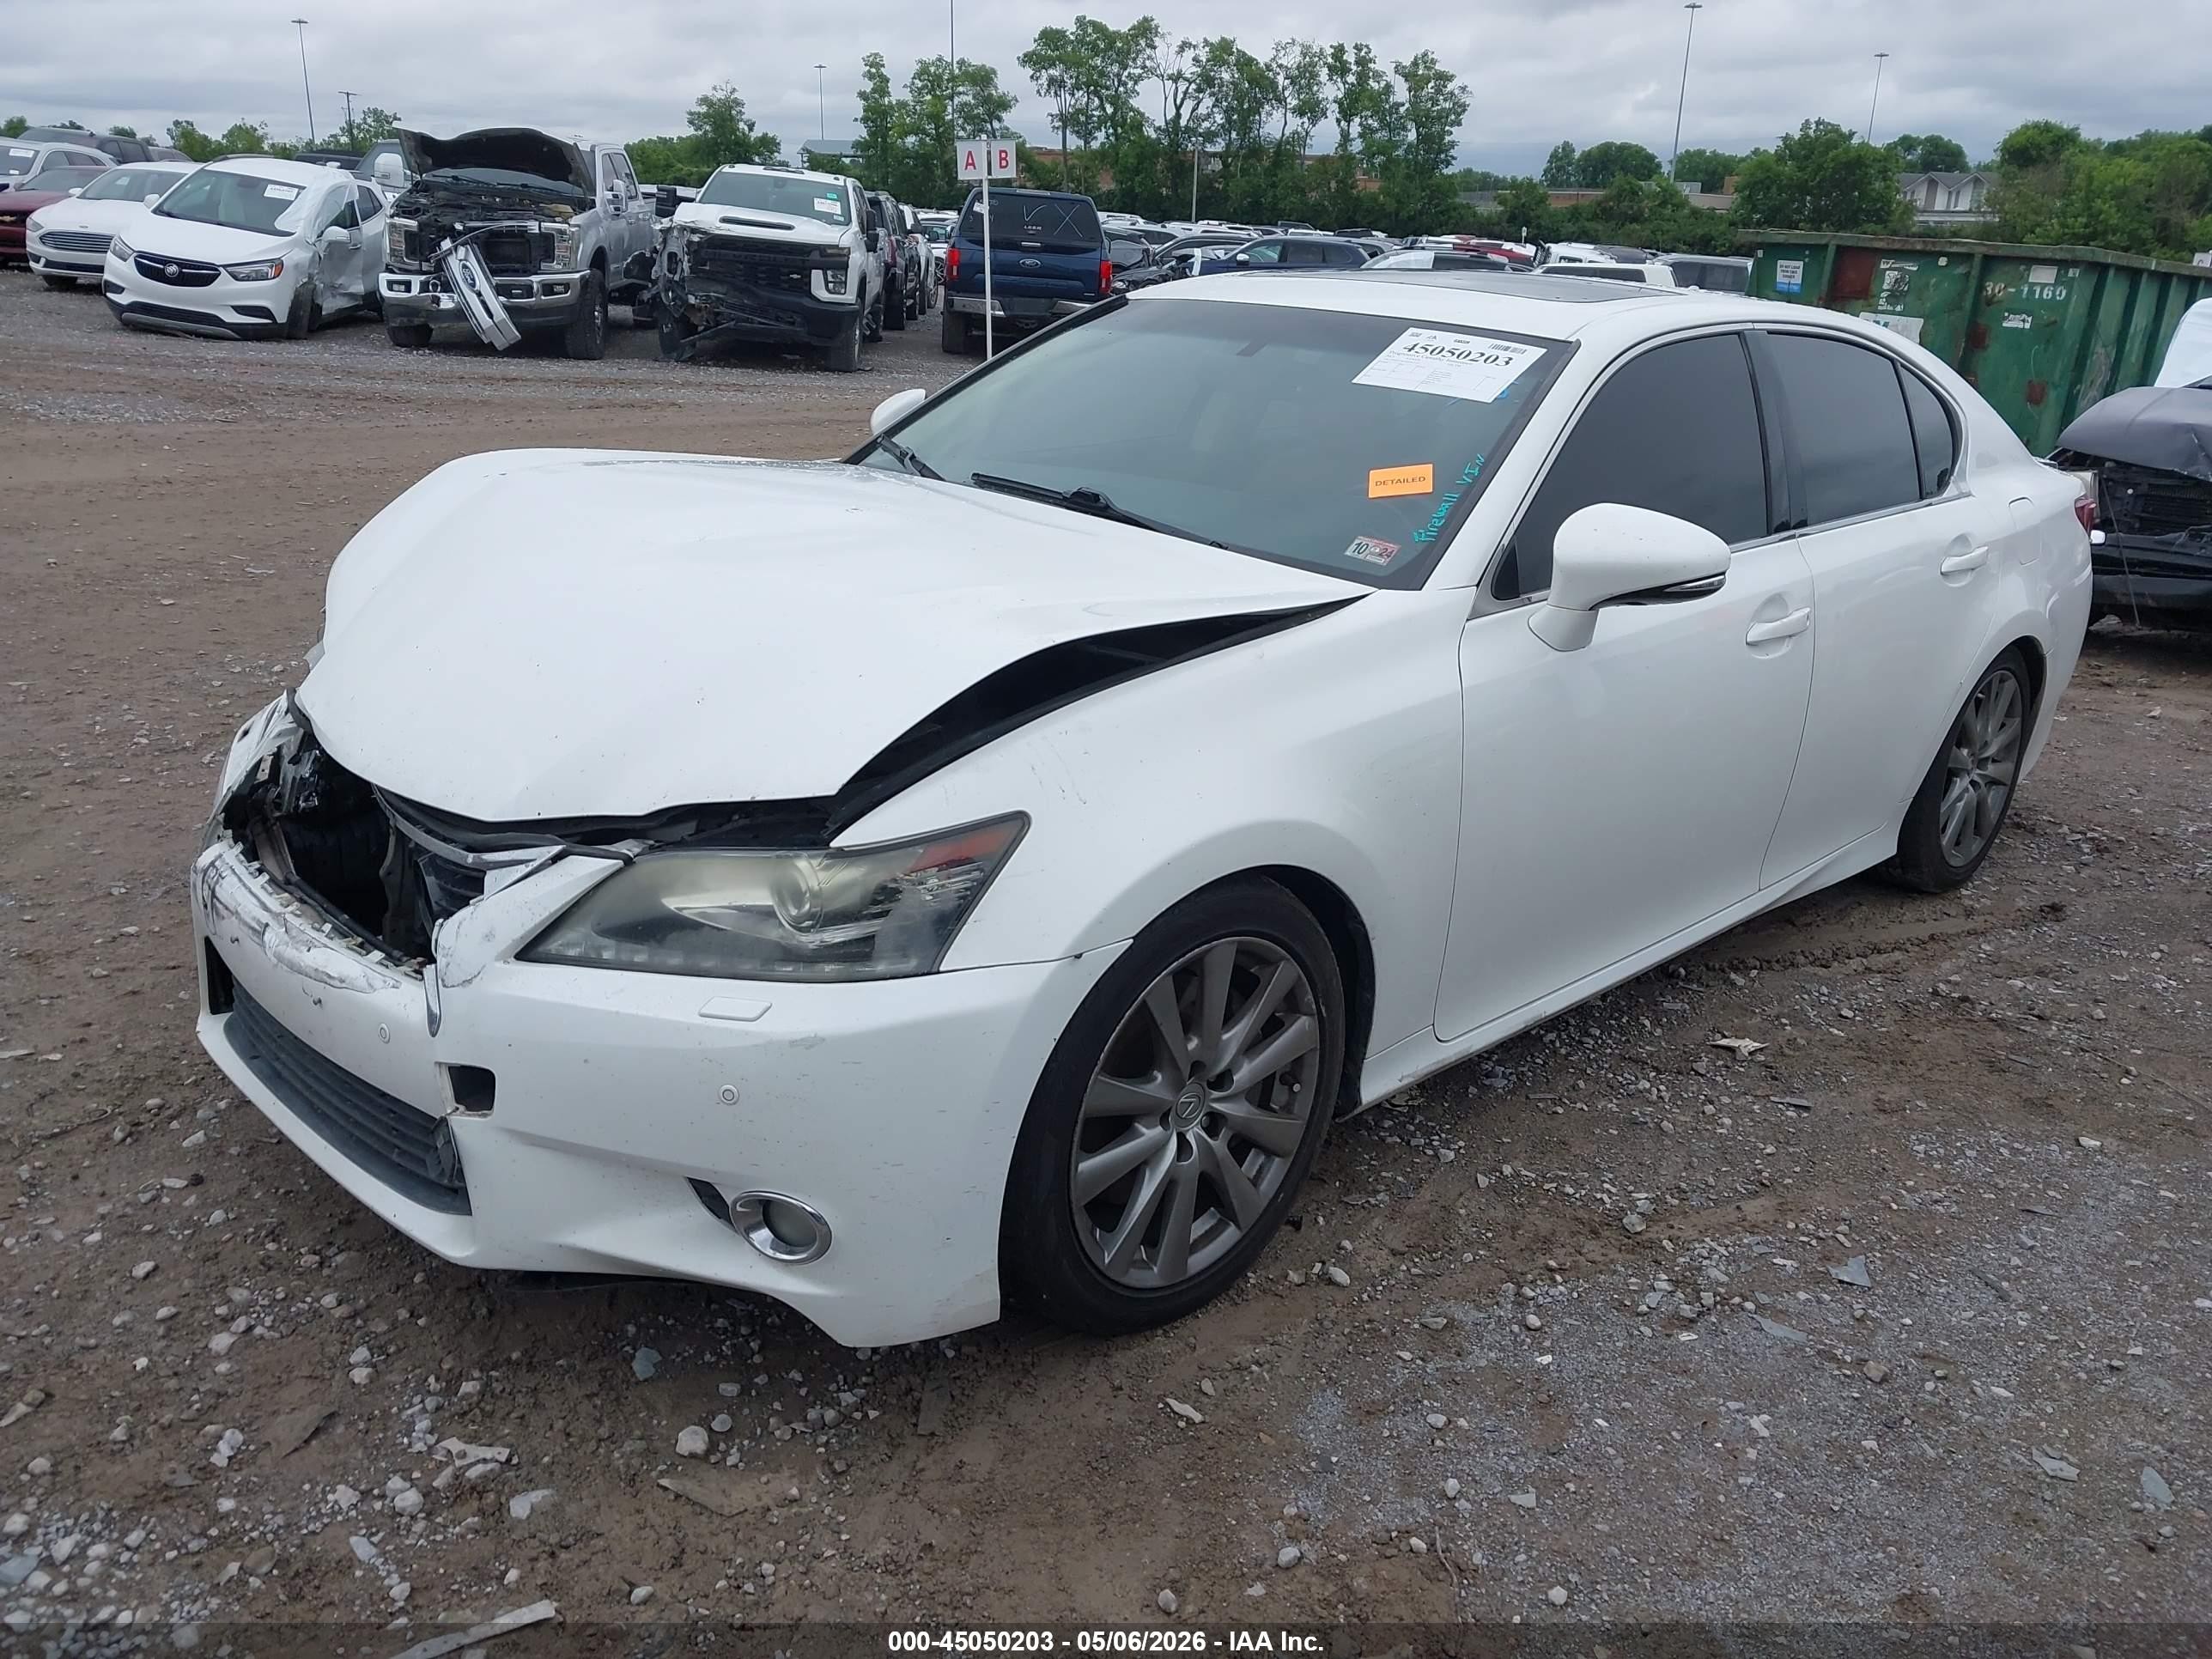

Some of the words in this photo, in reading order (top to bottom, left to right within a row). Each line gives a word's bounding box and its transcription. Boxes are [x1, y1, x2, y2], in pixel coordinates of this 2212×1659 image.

[964, 150, 976, 171] A
[999, 149, 1009, 169] B
[1403, 343, 1513, 367] 45050203
[1375, 476, 1426, 487] DETAILED
[1352, 541, 1370, 556] 10
[1379, 547, 1395, 559] 24
